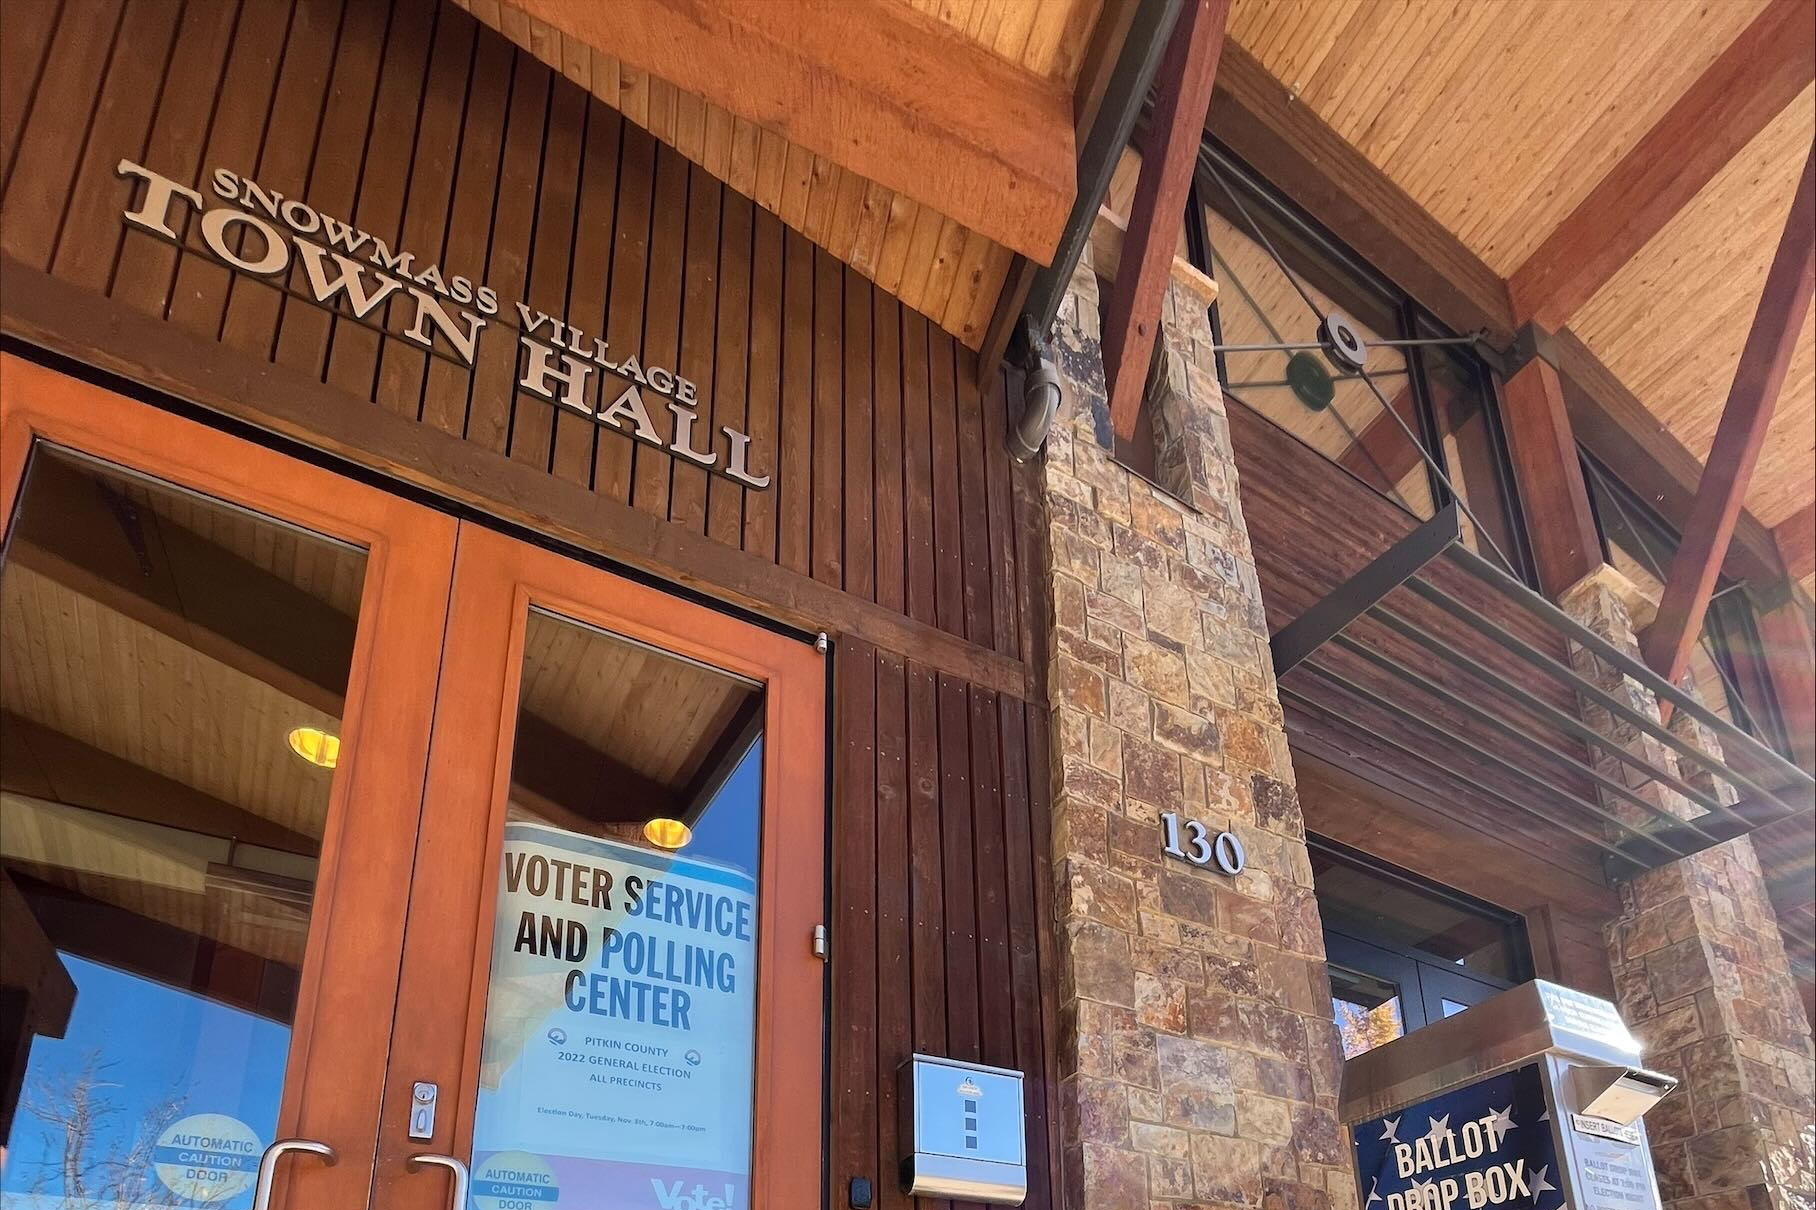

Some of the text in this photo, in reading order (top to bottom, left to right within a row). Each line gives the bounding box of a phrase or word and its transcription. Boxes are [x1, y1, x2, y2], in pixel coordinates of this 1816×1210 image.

[212, 168, 699, 408] SNOWMASS VILLAGE
[117, 158, 772, 490] TOWN HALL
[1161, 811, 1246, 875] 130
[504, 852, 751, 943] VOTER SERVICE
[513, 911, 736, 994] AND POLLING
[564, 968, 692, 1032] CENTER
[585, 1036, 669, 1058] PITKIN COUNTY
[557, 1051, 692, 1079] 2022 GENERAL ELECTION
[589, 1073, 663, 1092] ALL PRECINCTS
[537, 1106, 567, 1117] Election
[172, 1134, 254, 1154] AUTOMATIC
[1394, 1115, 1499, 1179] BALLOT
[178, 1152, 242, 1167] CAUTION
[186, 1168, 228, 1183] DOOR
[485, 1168, 550, 1185] AUTOMATIC
[1464, 1158, 1532, 1210] BOX
[491, 1184, 543, 1198] CAUTION
